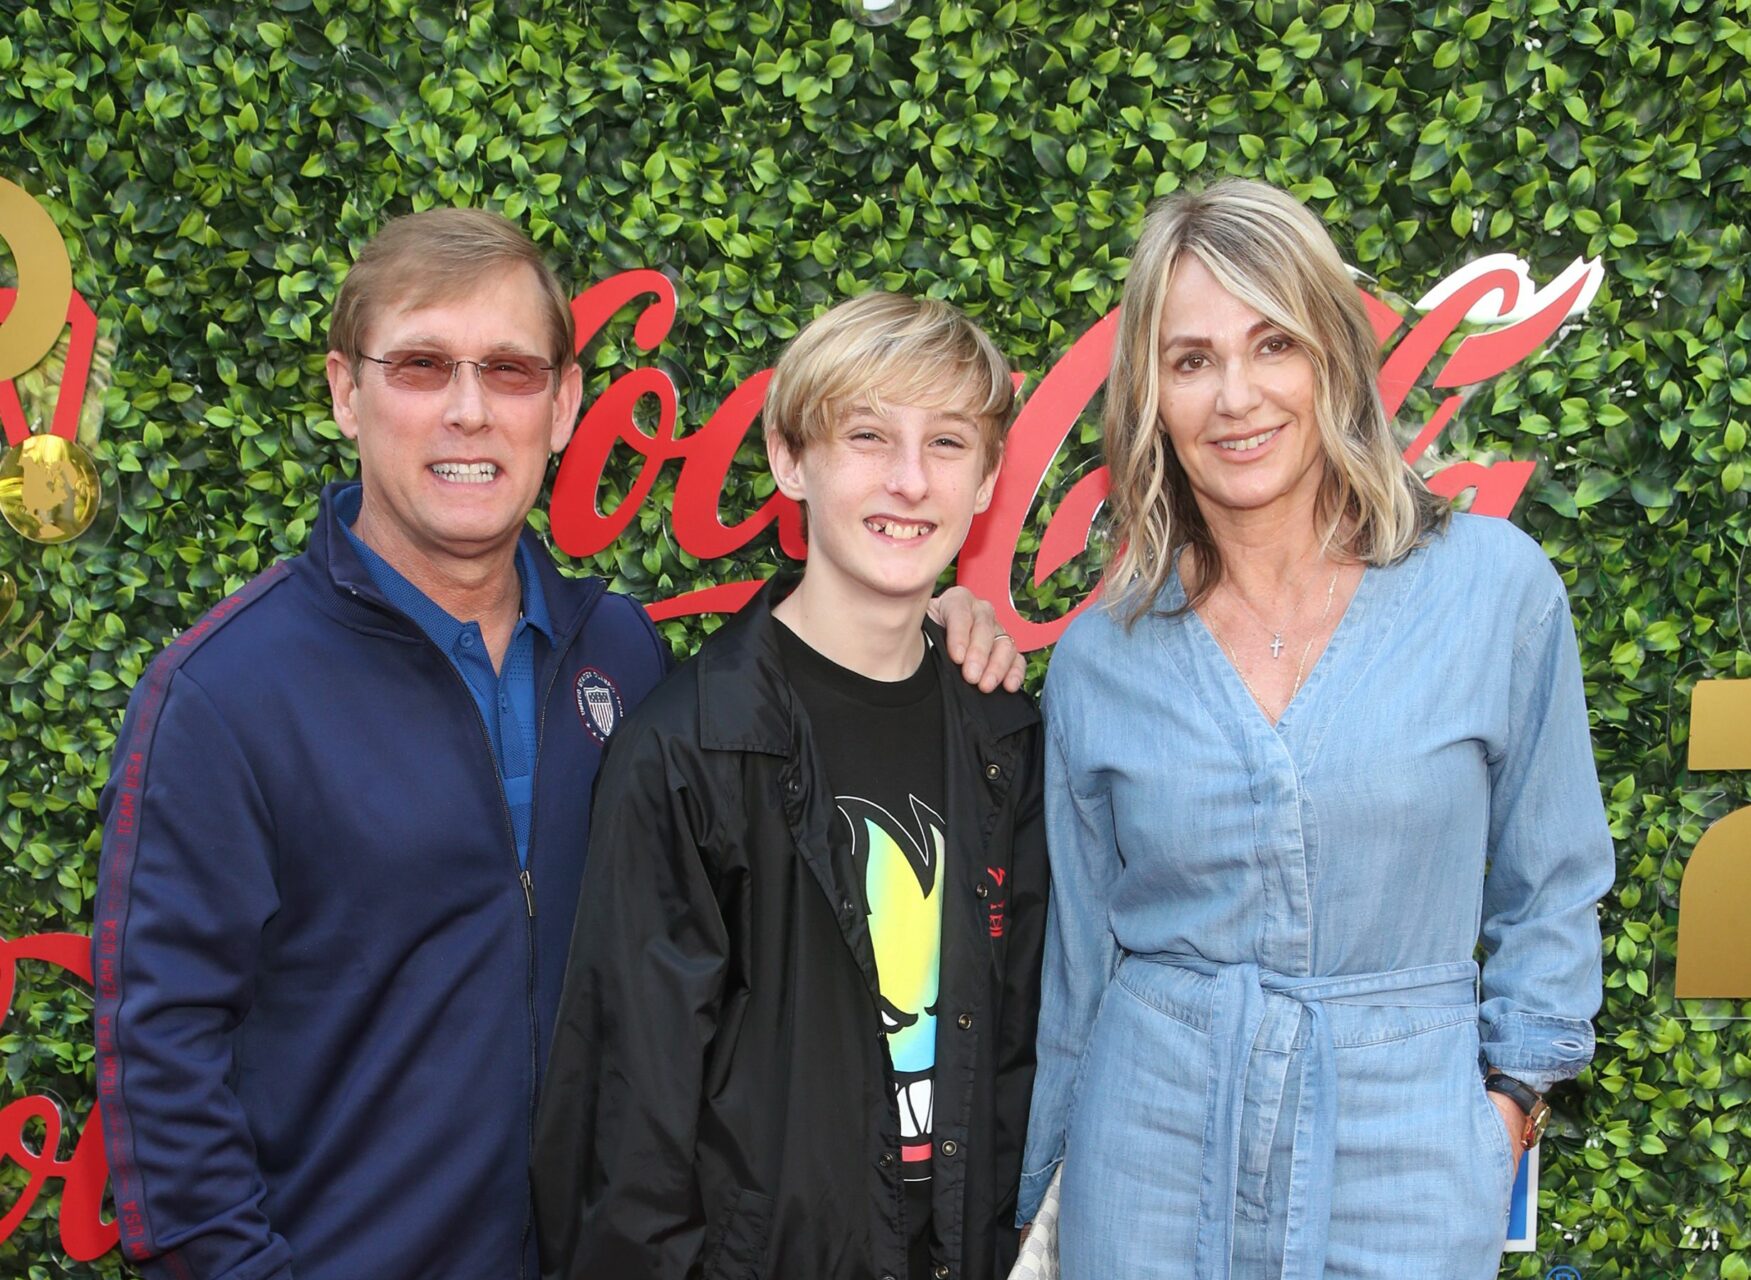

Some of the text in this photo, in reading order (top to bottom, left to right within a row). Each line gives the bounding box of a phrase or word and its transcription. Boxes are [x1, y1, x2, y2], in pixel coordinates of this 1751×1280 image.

[124, 751, 144, 789] USA
[116, 795, 135, 834] TEAM
[99, 918, 118, 954] USA
[99, 959, 118, 1000] TEAM
[97, 1015, 118, 1095] TEAM USA
[121, 1199, 145, 1238] USA
